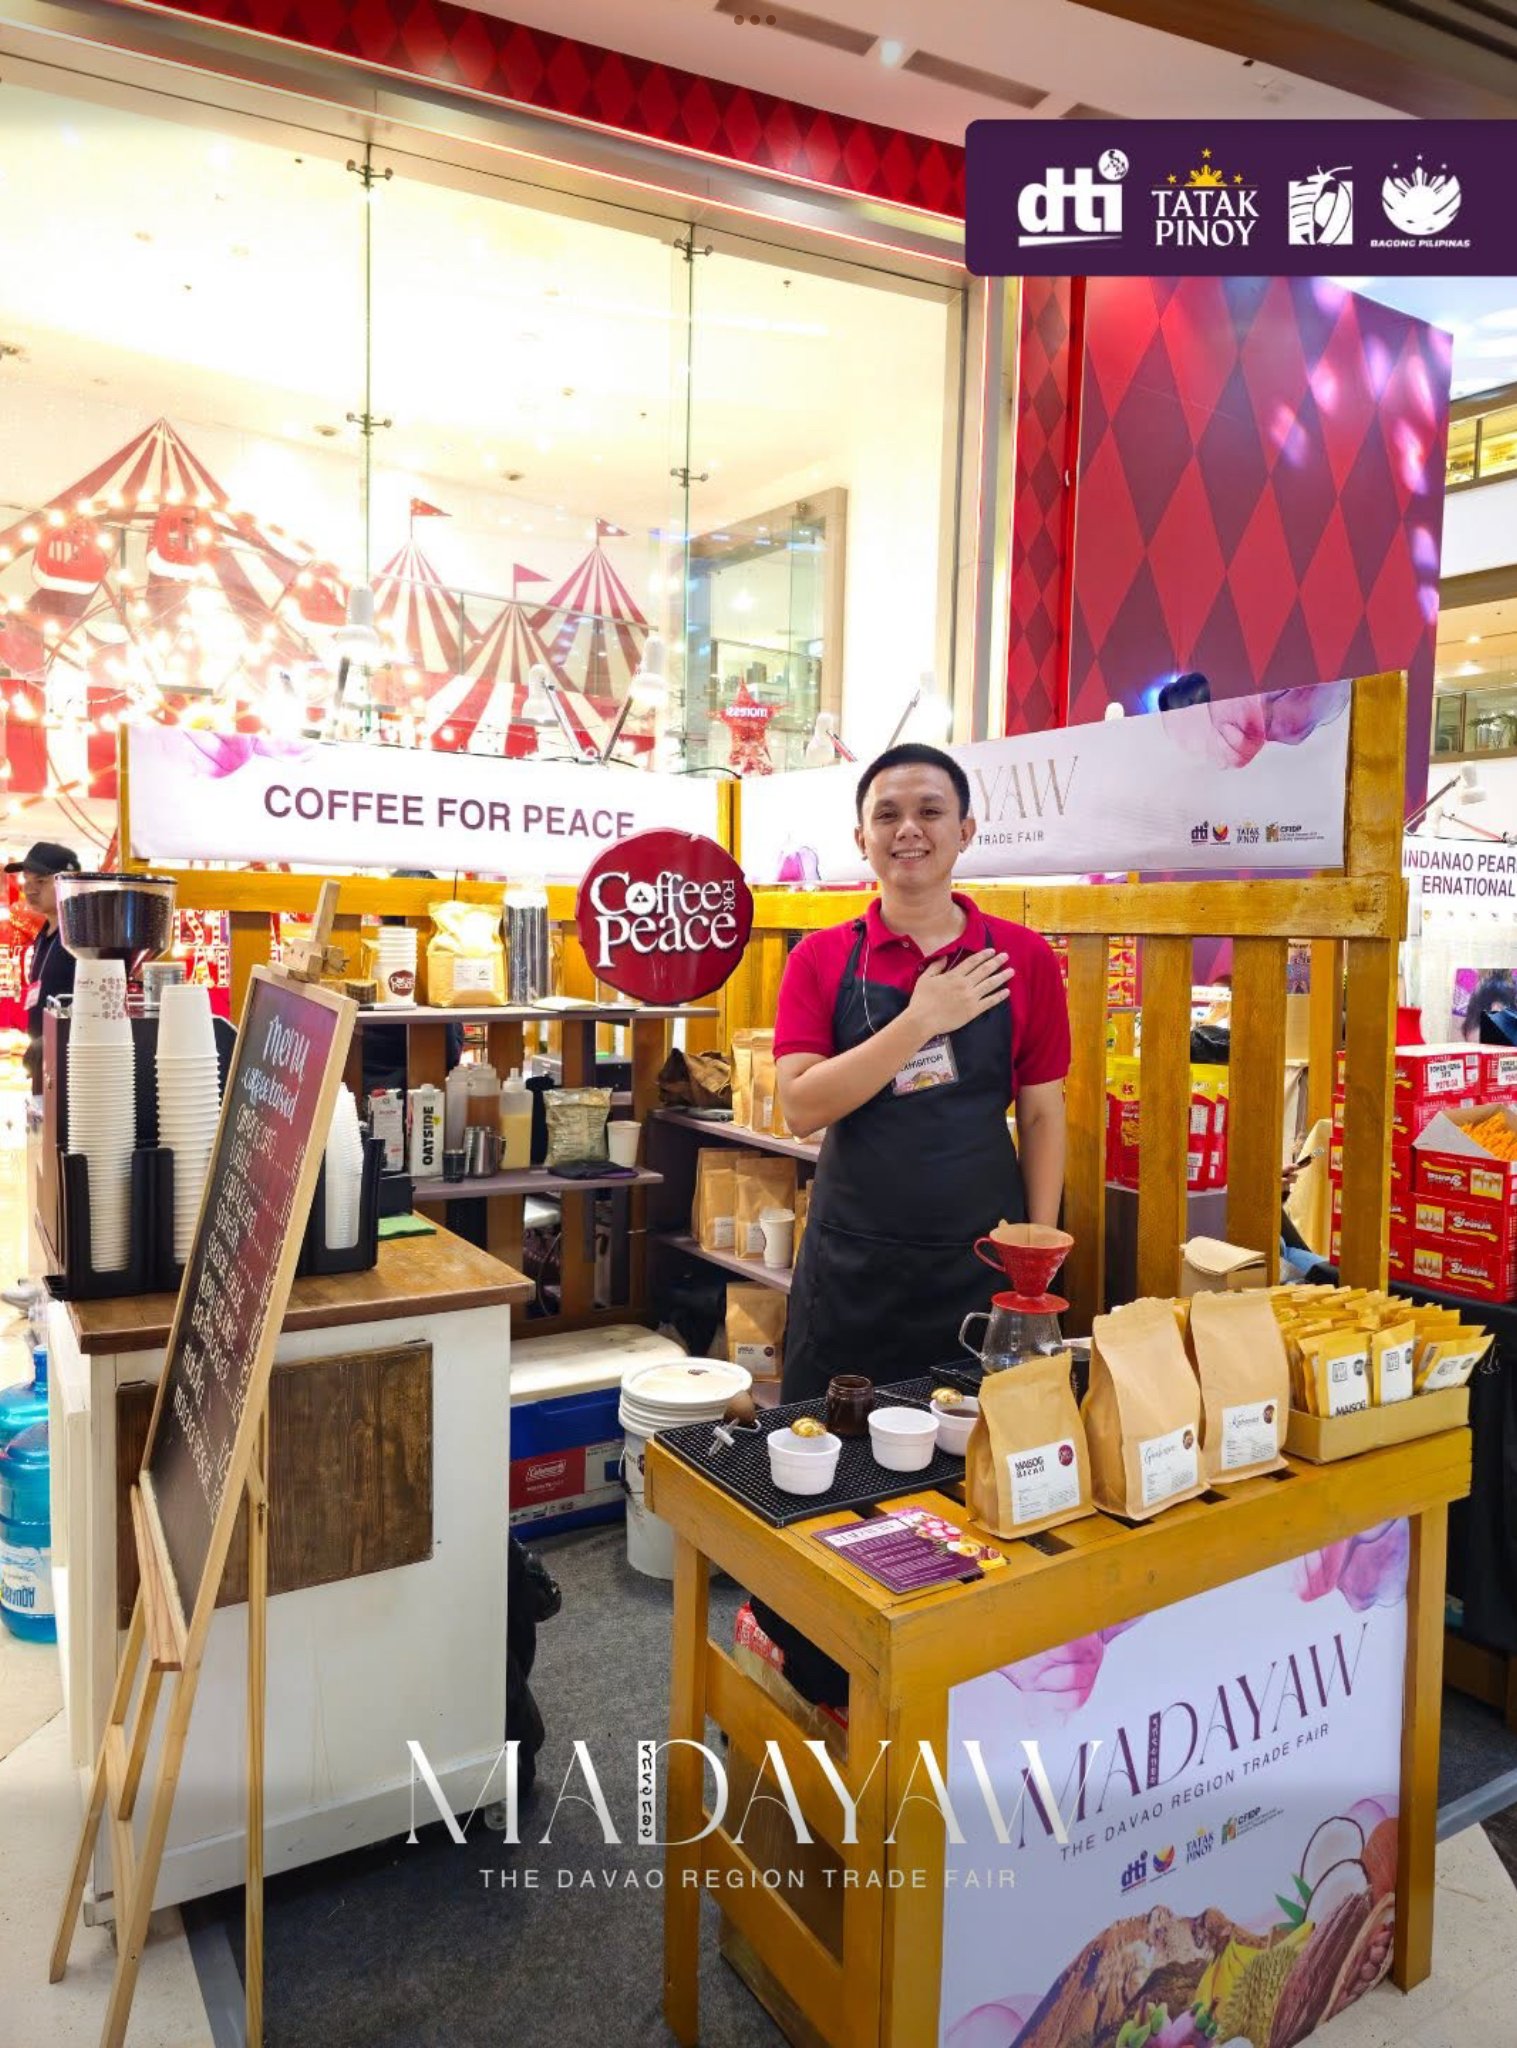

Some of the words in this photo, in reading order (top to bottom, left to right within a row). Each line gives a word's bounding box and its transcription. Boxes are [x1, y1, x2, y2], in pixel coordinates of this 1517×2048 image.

[264, 784, 424, 826] COFFEE
[437, 797, 511, 832] FOR
[523, 804, 634, 839] PEACE
[978, 832, 1013, 845] TRADE
[1017, 829, 1044, 843] FAIR
[1403, 849, 1474, 871] INDANAO
[1477, 854, 1517, 873] PEAR
[590, 871, 723, 917] Coffee
[722, 879, 736, 912] FOR
[1421, 875, 1516, 897] ERNATIONAL
[421, 1105, 435, 1166] OATSIDE
[1018, 1622, 1369, 1850] MADAYAW
[1060, 1832, 1095, 1862] THE
[1105, 1802, 1163, 1842] DAVAO
[1171, 1769, 1234, 1809] REGION
[1242, 1741, 1290, 1777] TRADE
[1296, 1723, 1330, 1749] FAIR
[1185, 1831, 1214, 1852] TATAK
[1185, 1844, 1213, 1865] PINOY
[1121, 1850, 1148, 1888] dti
